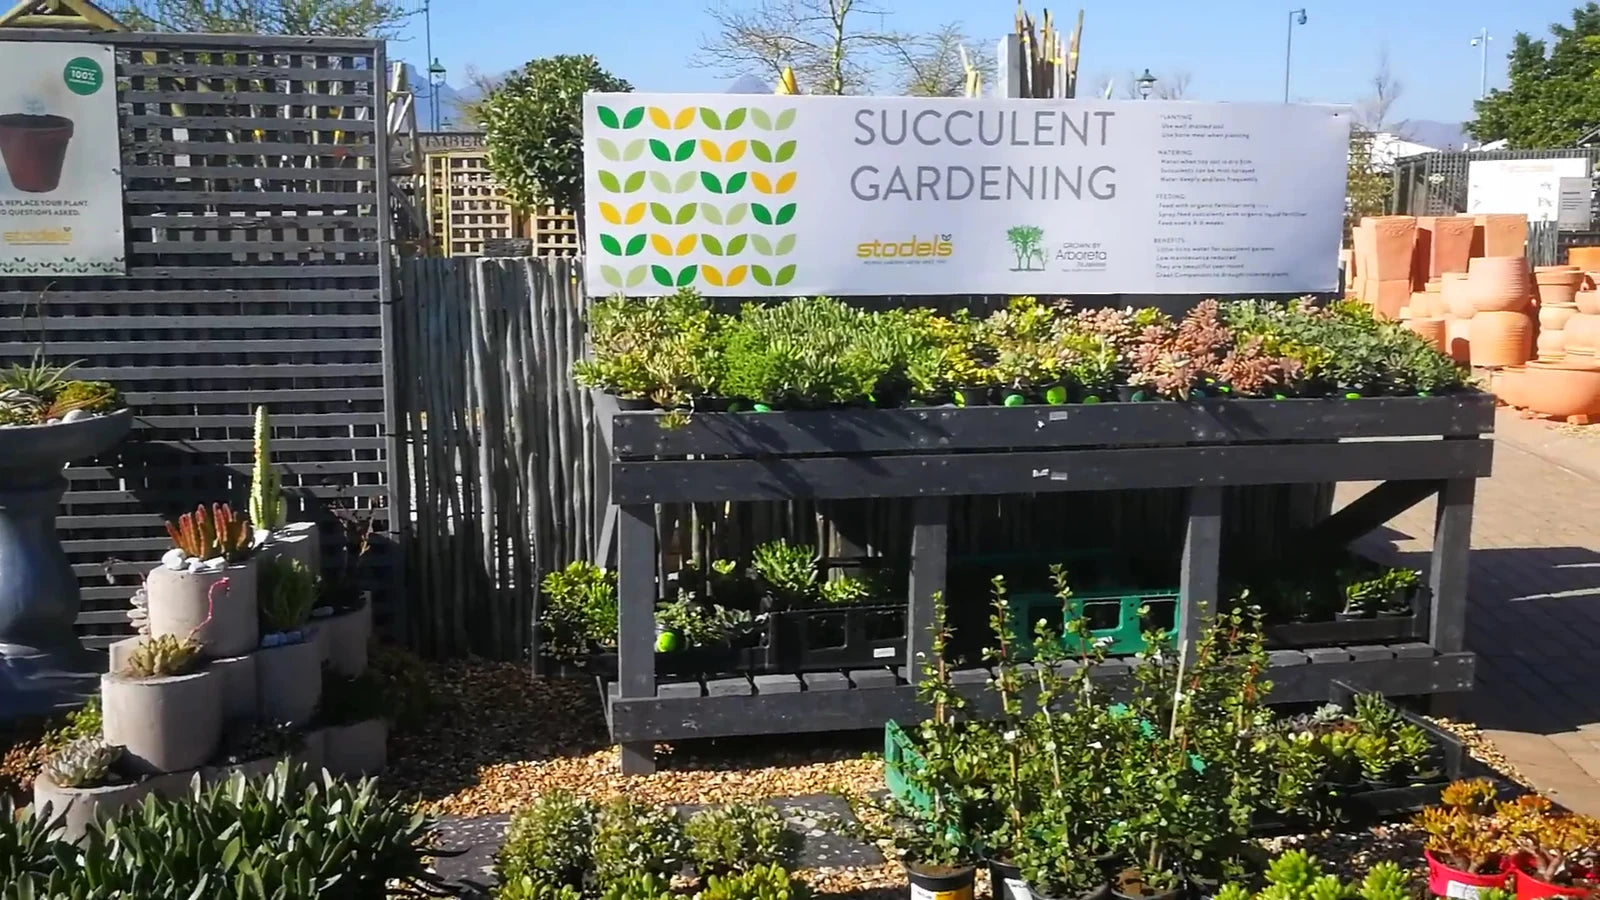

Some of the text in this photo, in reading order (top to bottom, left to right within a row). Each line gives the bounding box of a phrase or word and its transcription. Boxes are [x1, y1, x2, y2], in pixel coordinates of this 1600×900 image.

[71, 70, 95, 80] 100%
[854, 108, 1116, 147] SUCCULENT
[850, 165, 1116, 202] GARDENING
[856, 234, 953, 258] stodels
[1056, 249, 1107, 261] Arboreta
